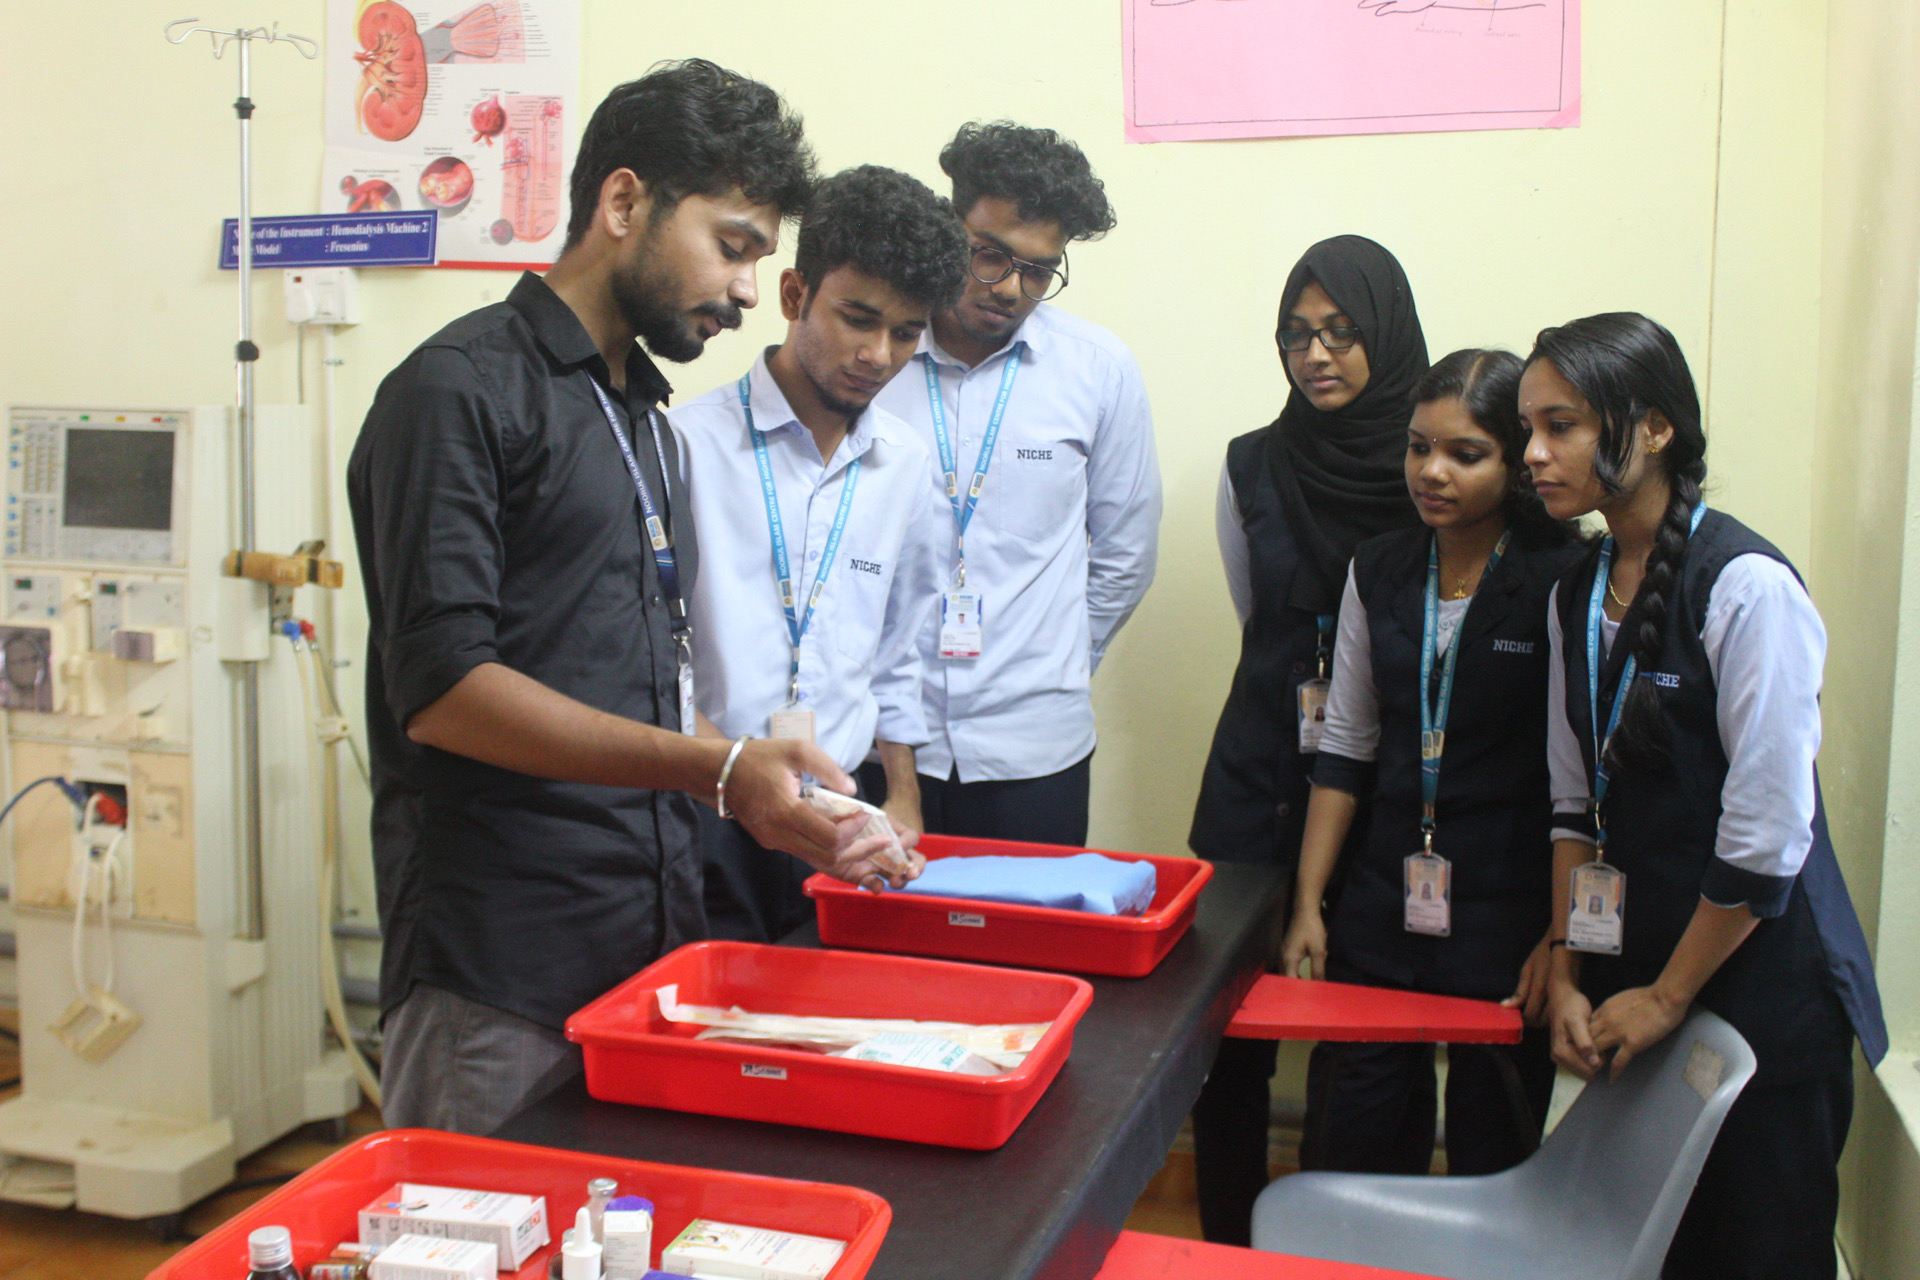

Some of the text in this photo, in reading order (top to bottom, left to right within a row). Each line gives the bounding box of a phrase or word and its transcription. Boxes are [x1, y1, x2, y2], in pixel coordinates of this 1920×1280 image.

[266, 228, 278, 238] the
[280, 226, 324, 238] Instrument
[332, 223, 384, 237] Hemodialysis
[386, 222, 420, 234] Machine
[422, 222, 428, 232] 2
[256, 244, 280, 255] Model
[330, 241, 368, 252] Fresenius
[999, 390, 1008, 402] FOR
[612, 423, 629, 452] CENTRE
[1016, 448, 1052, 460] NICHE
[626, 454, 640, 479] ISLAM
[637, 480, 652, 514] NOORUL
[765, 481, 774, 496] FOR
[768, 496, 778, 522] CENTRE
[836, 504, 848, 529] CENTRE
[843, 491, 852, 504] FOR
[850, 558, 882, 576] NICHE
[1492, 639, 1534, 654] NICHE
